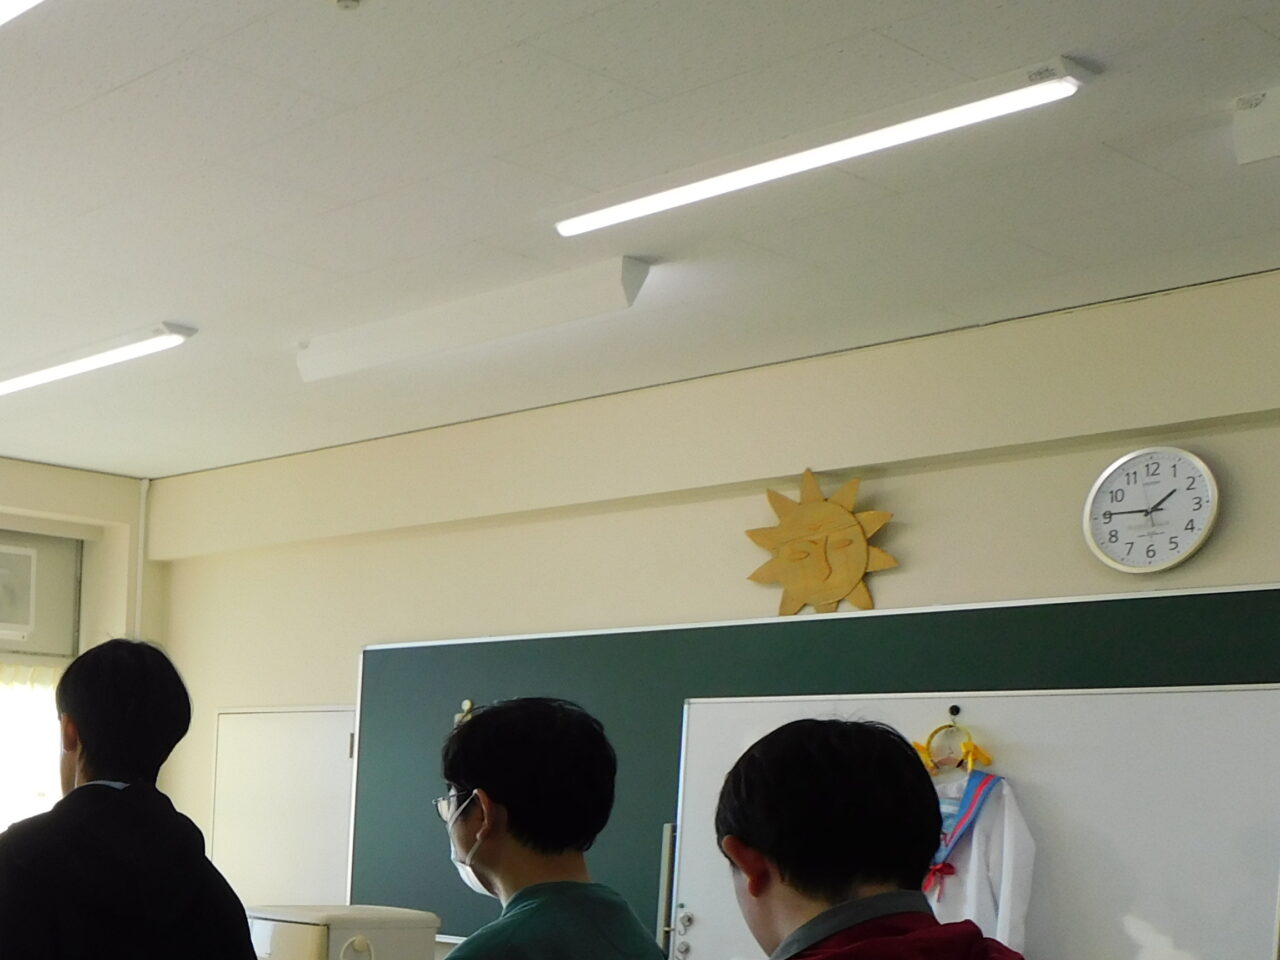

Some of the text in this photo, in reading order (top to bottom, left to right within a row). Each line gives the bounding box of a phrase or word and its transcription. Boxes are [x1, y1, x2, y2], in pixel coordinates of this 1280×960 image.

[1145, 461, 1161, 477] 12
[1170, 464, 1177, 478] 1
[1125, 471, 1138, 485] 11
[1185, 476, 1196, 491] 2
[1109, 488, 1125, 503] 10
[1192, 497, 1203, 511] 3
[1102, 510, 1113, 525] 9
[1184, 519, 1196, 533] 4
[1108, 529, 1119, 544] 8
[1169, 536, 1179, 551] 5
[1125, 541, 1135, 556] 7
[1145, 544, 1156, 558] 6
